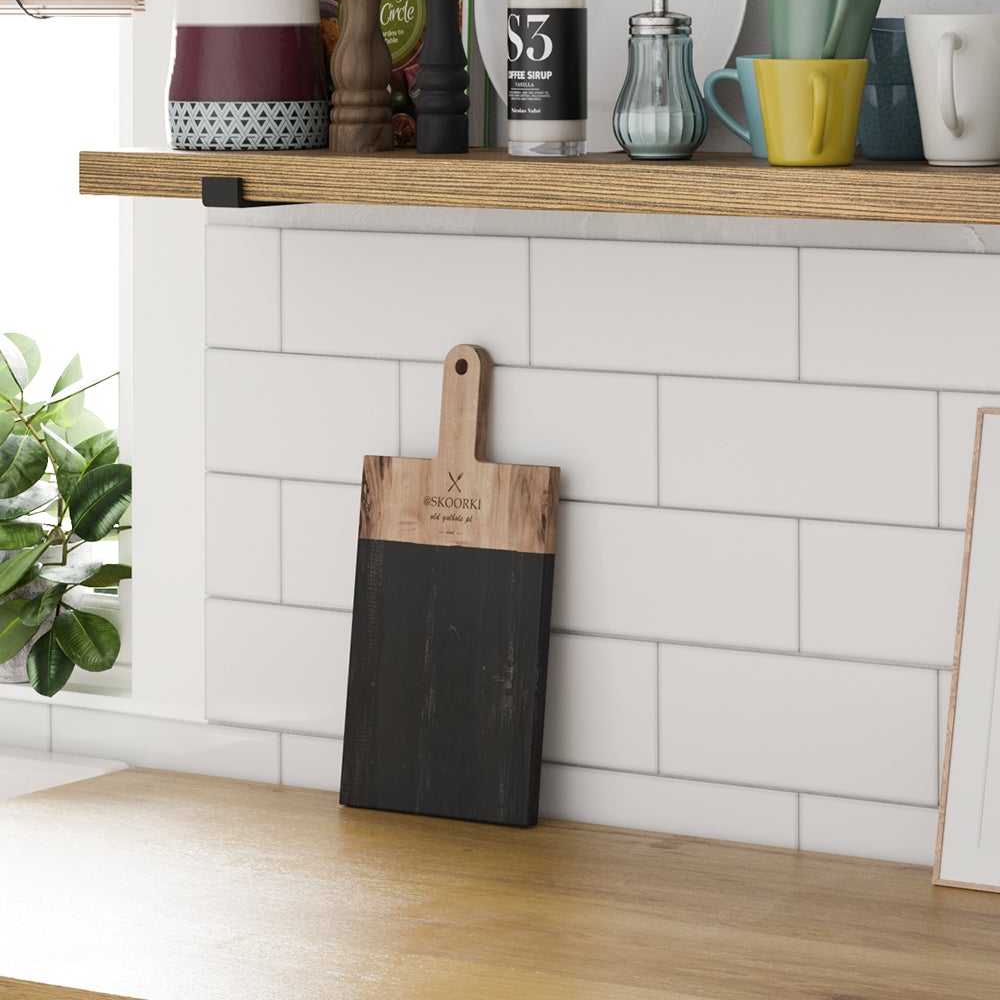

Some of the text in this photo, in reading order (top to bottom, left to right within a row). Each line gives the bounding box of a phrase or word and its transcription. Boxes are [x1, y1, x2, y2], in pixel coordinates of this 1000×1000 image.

[380, 0, 415, 26] Circle
[507, 13, 553, 62] S3
[527, 70, 553, 80] SIRUP
